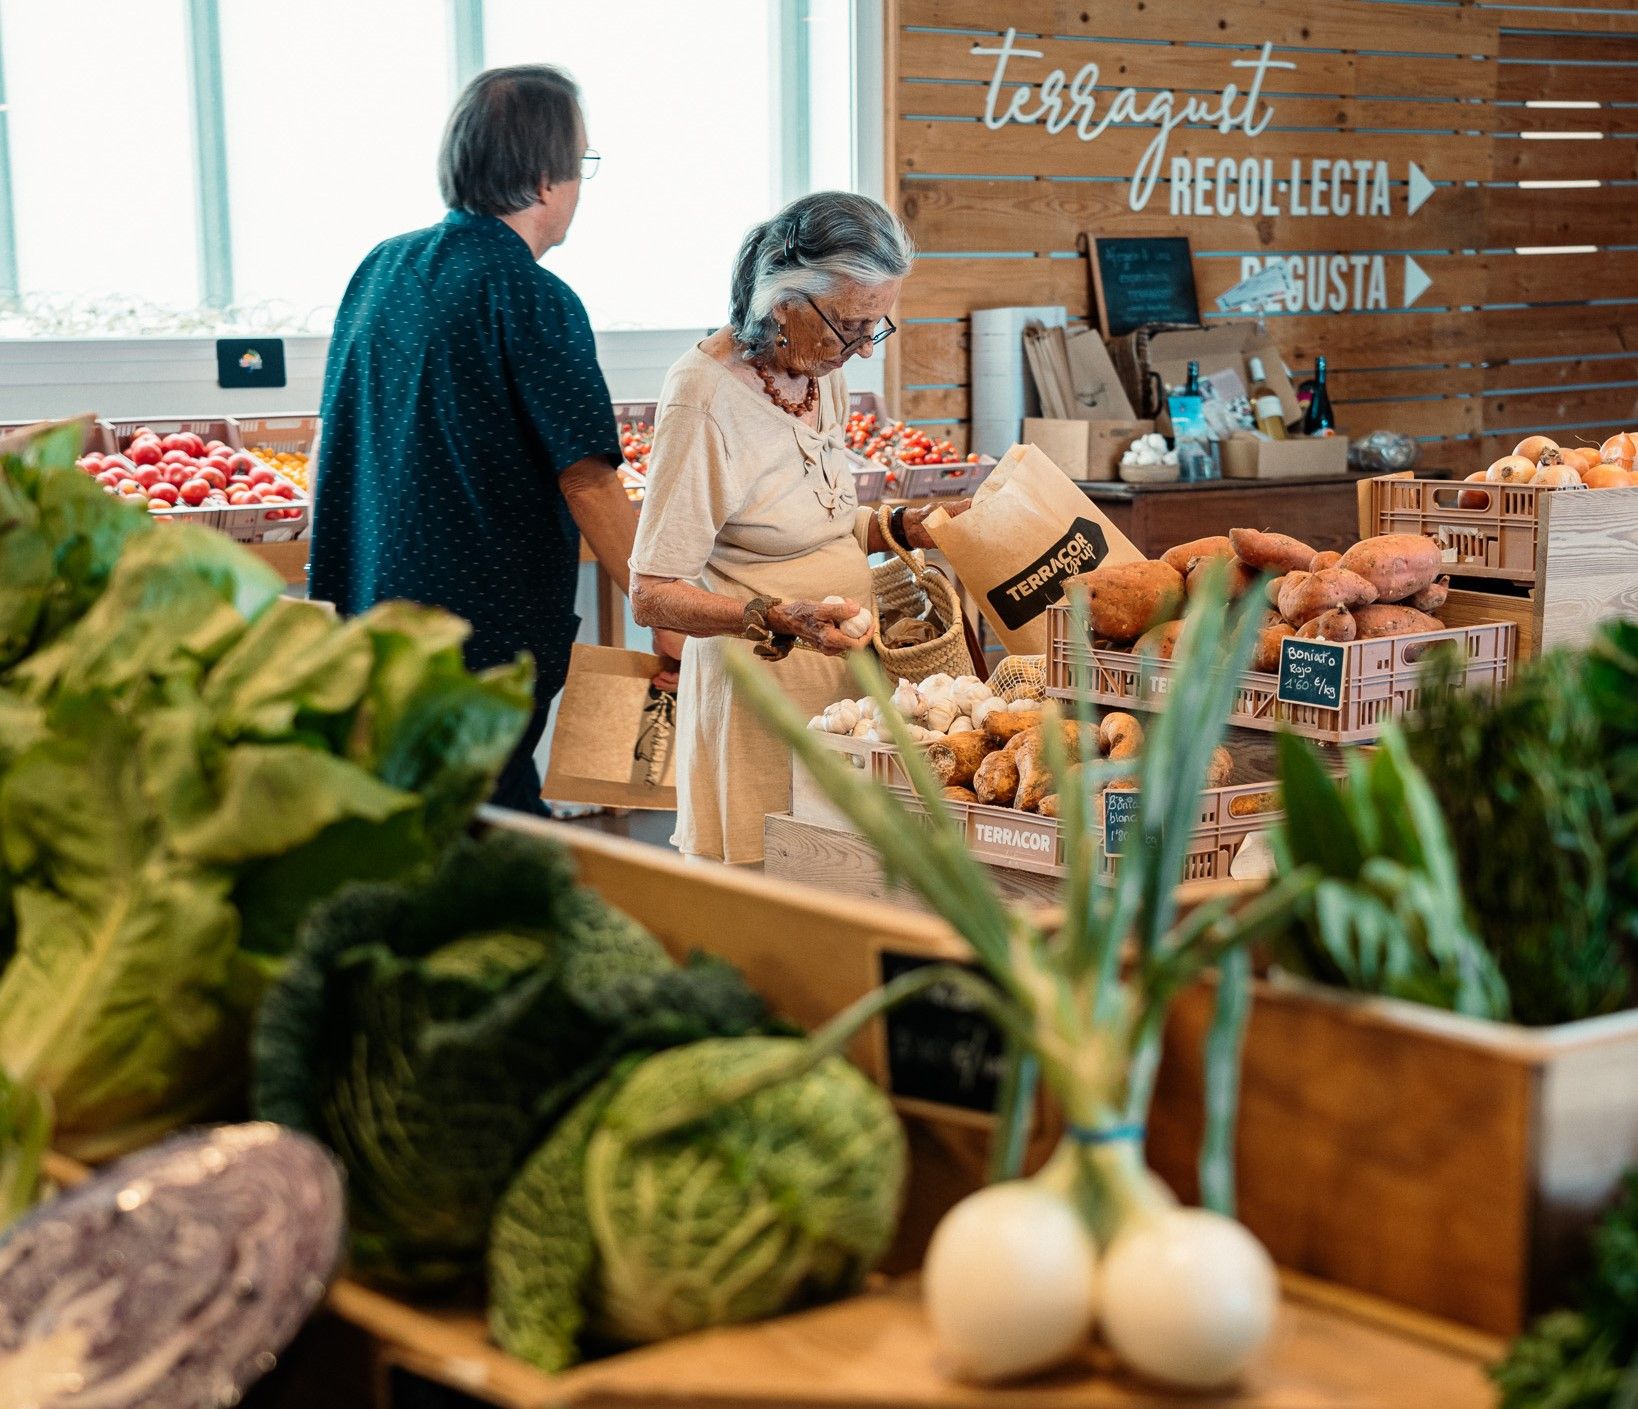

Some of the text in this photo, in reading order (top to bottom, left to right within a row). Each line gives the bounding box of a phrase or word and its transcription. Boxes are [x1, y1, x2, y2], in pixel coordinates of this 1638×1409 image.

[970, 27, 1297, 212] terragust
[1006, 532, 1088, 601] TERRACOR
[1288, 647, 1336, 666] Boniato
[1289, 663, 1312, 678] Rojo
[1108, 794, 1138, 811] Bonia
[1109, 812, 1137, 824] blanc
[975, 823, 1051, 852] TERRACOR
